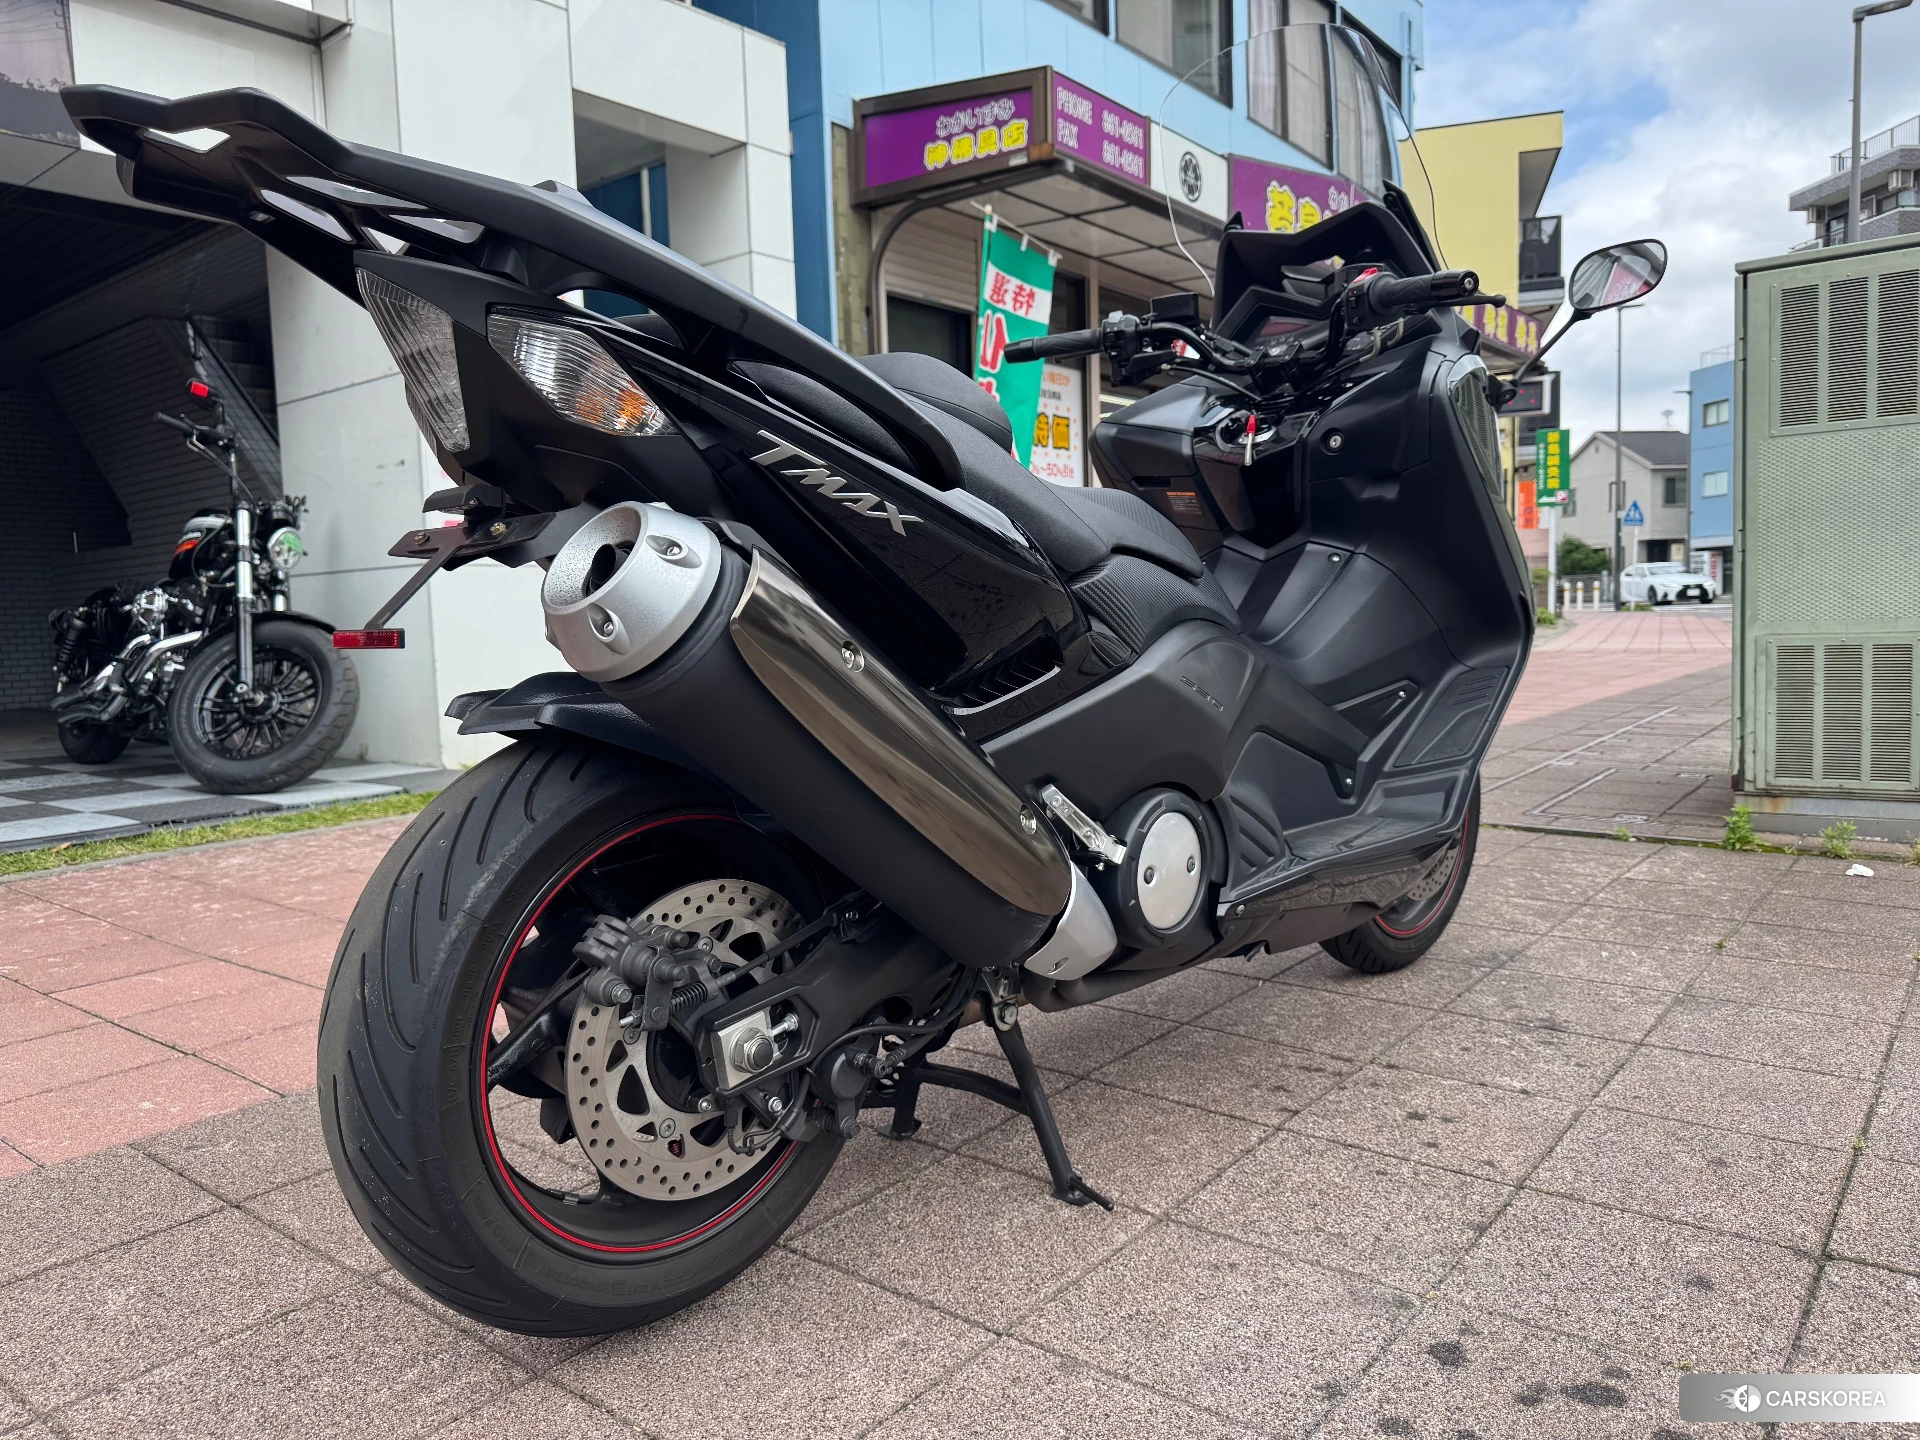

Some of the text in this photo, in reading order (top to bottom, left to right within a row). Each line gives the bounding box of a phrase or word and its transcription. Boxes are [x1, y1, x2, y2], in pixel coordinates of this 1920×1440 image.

[1057, 86, 1093, 126] PHONE
[1057, 116, 1079, 150] FAX
[750, 429, 924, 537] TMAX
